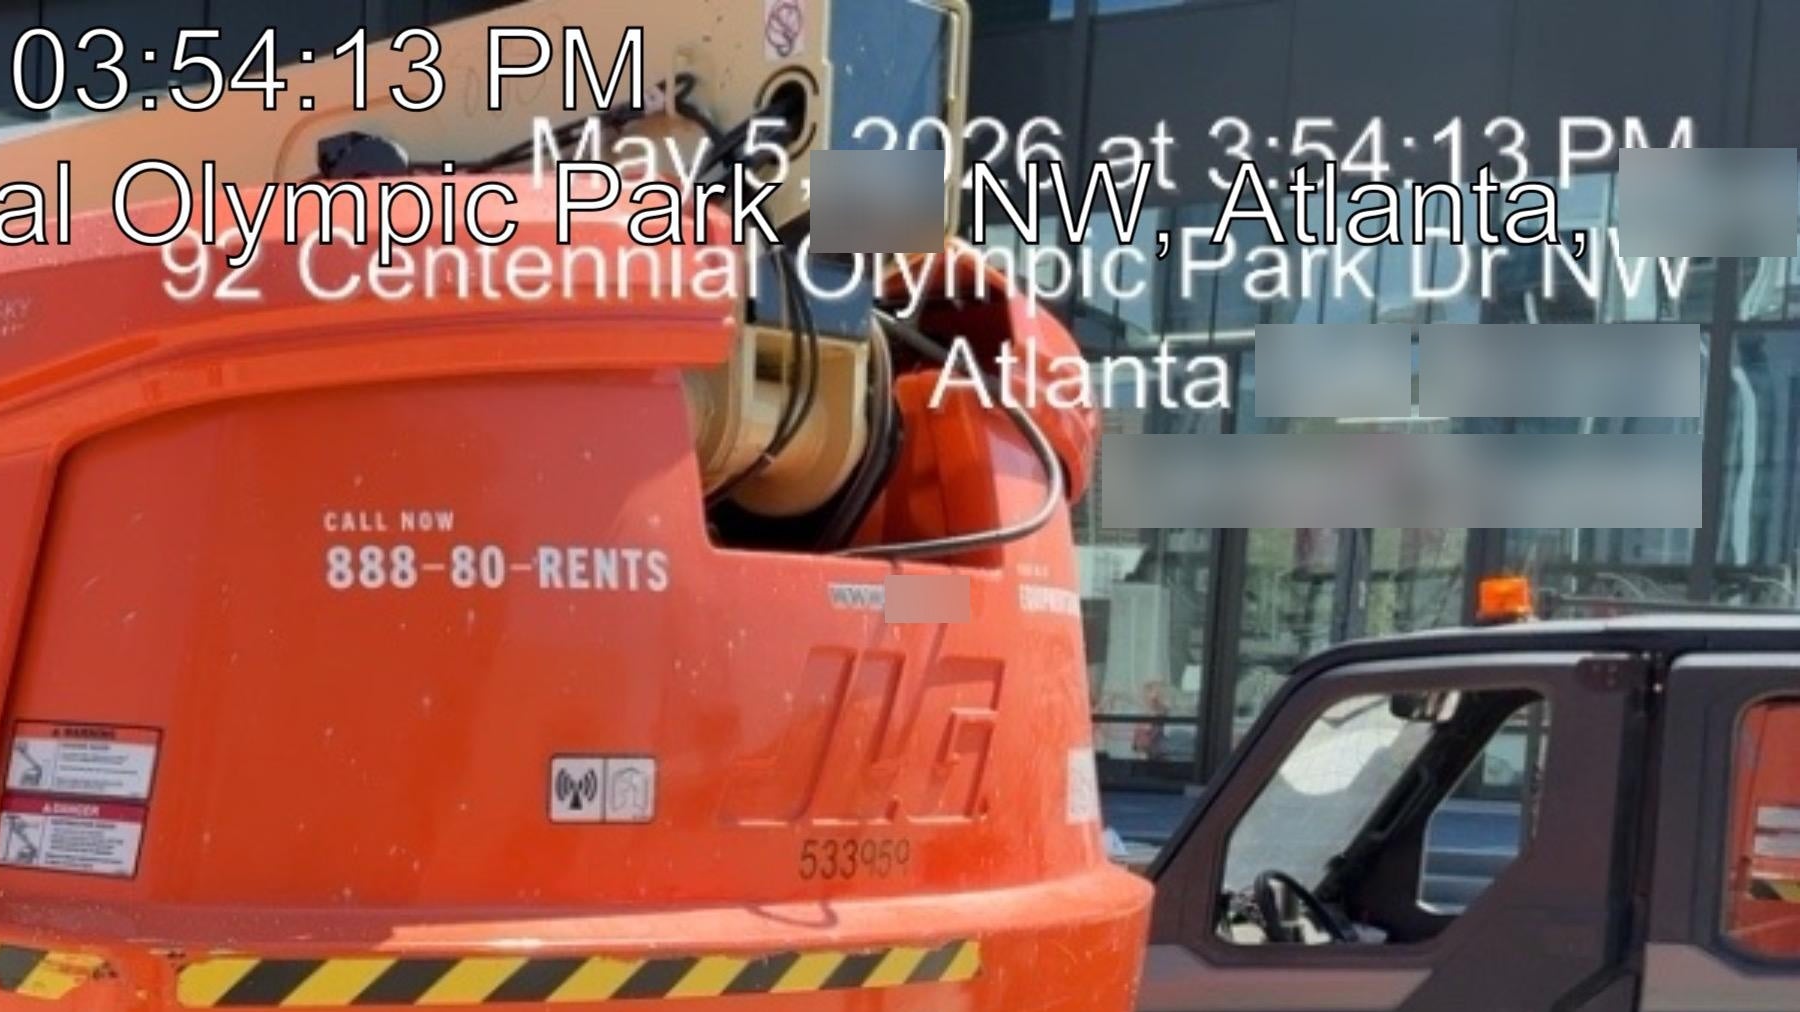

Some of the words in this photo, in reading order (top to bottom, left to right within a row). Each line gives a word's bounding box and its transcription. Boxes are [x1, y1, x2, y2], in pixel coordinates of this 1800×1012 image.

[323, 512, 387, 532] CALL
[401, 512, 455, 532] NOW
[325, 545, 669, 592] 888-80-RENTS
[799, 838, 910, 879] 533959
